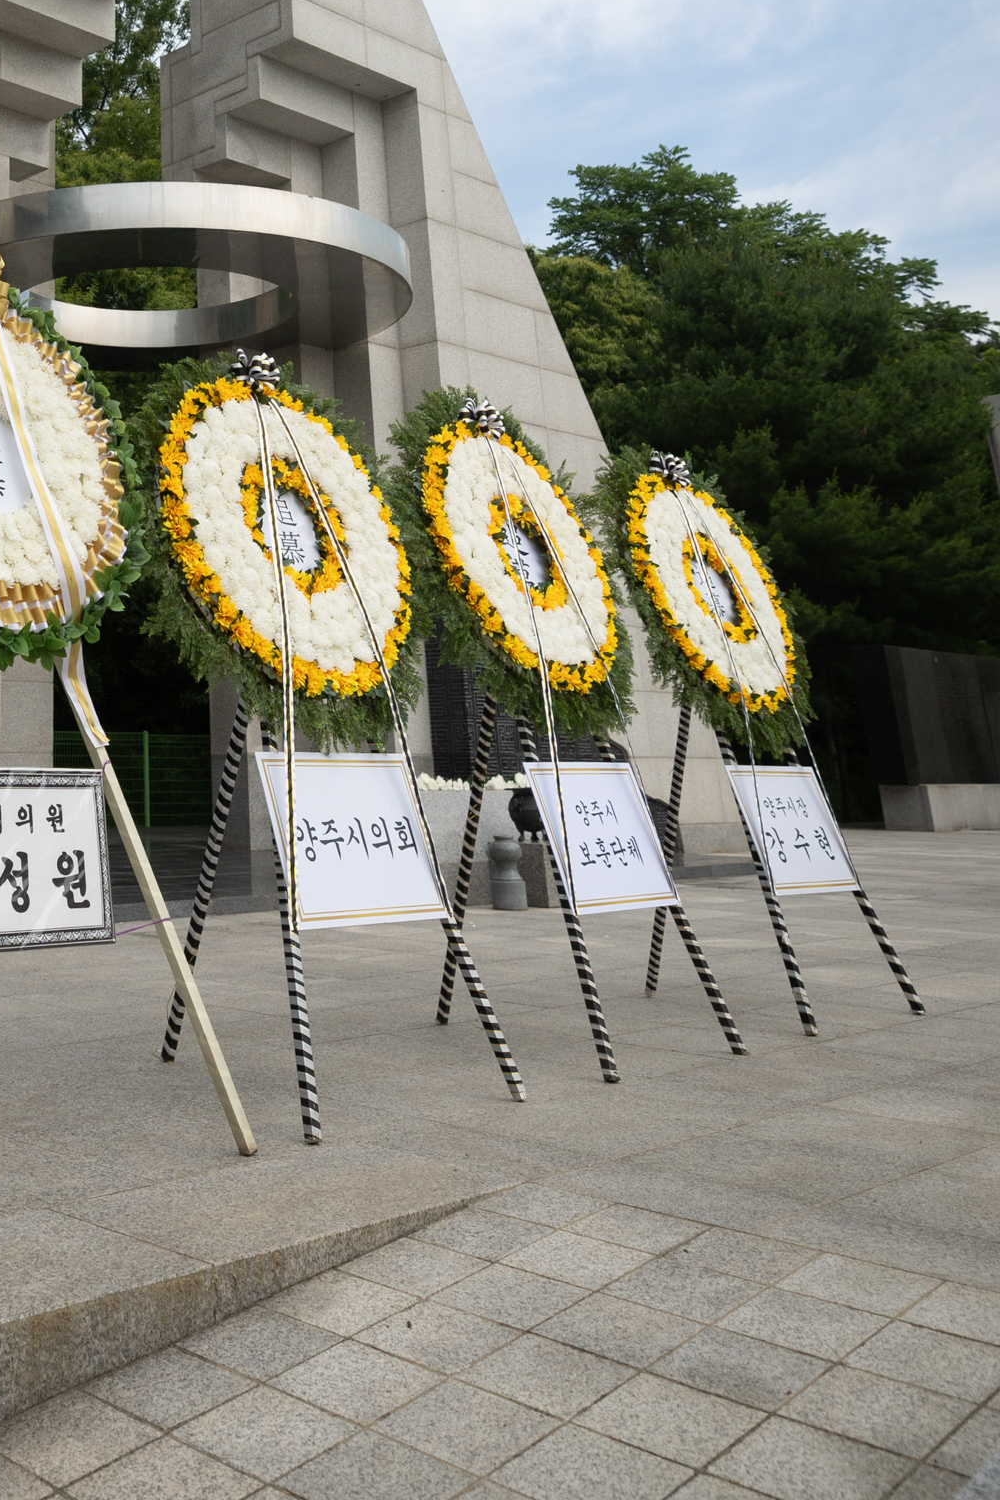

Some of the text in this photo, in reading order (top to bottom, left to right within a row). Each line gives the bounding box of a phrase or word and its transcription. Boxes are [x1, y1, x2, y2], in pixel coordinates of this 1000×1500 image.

[575, 799, 619, 827] 양주시
[763, 796, 809, 819] 양주시장
[296, 815, 419, 862] 양주시의회
[579, 835, 645, 869] 보훈단체
[765, 826, 836, 863] 강수현
